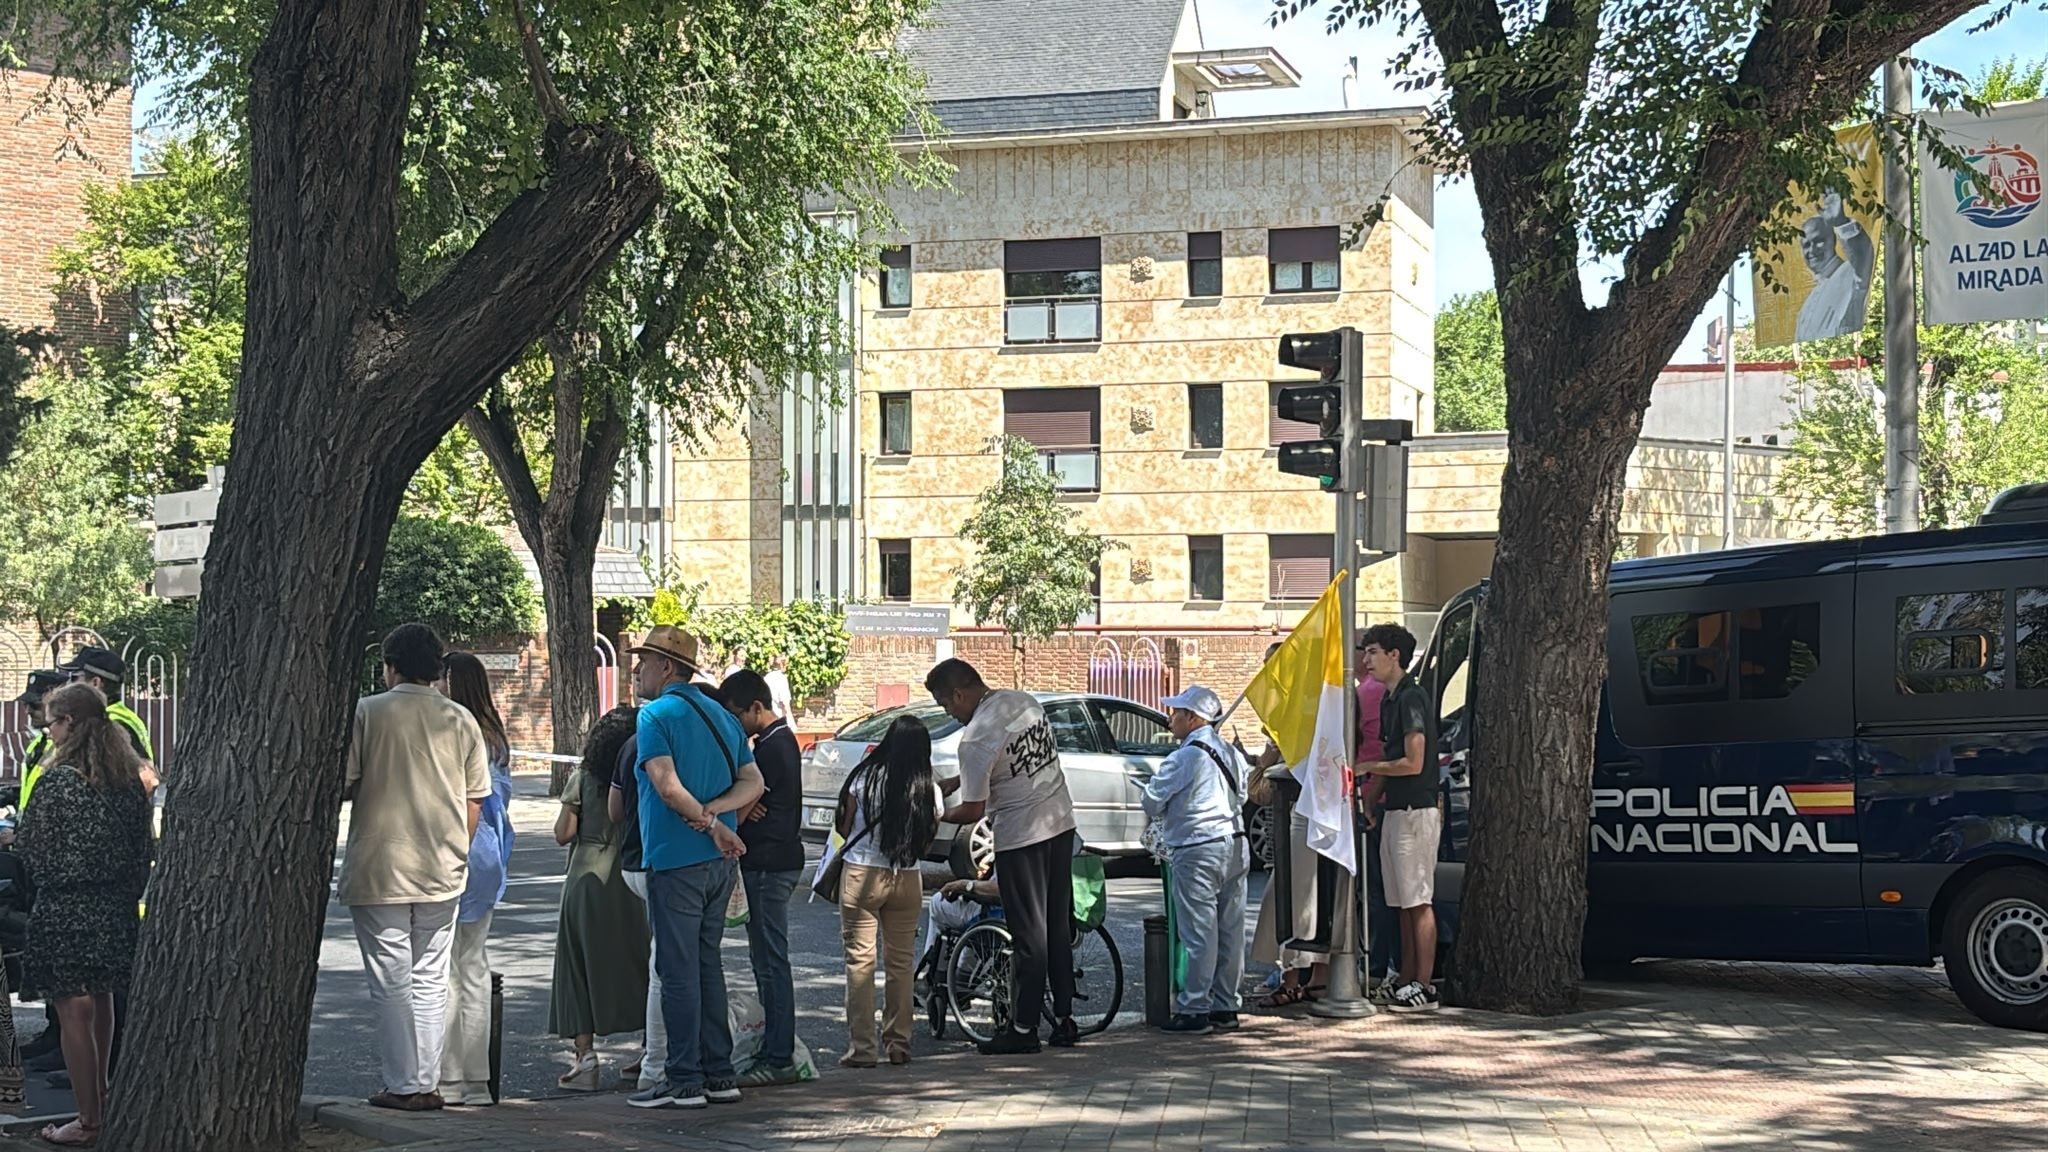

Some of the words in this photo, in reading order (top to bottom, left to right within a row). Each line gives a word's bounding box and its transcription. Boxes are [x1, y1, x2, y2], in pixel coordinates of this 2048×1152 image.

[1949, 241, 2016, 264] ALZAD
[2023, 238, 2048, 259] LA
[1958, 266, 2043, 292] MIRADA
[1590, 821, 1859, 853] NACIONAL
